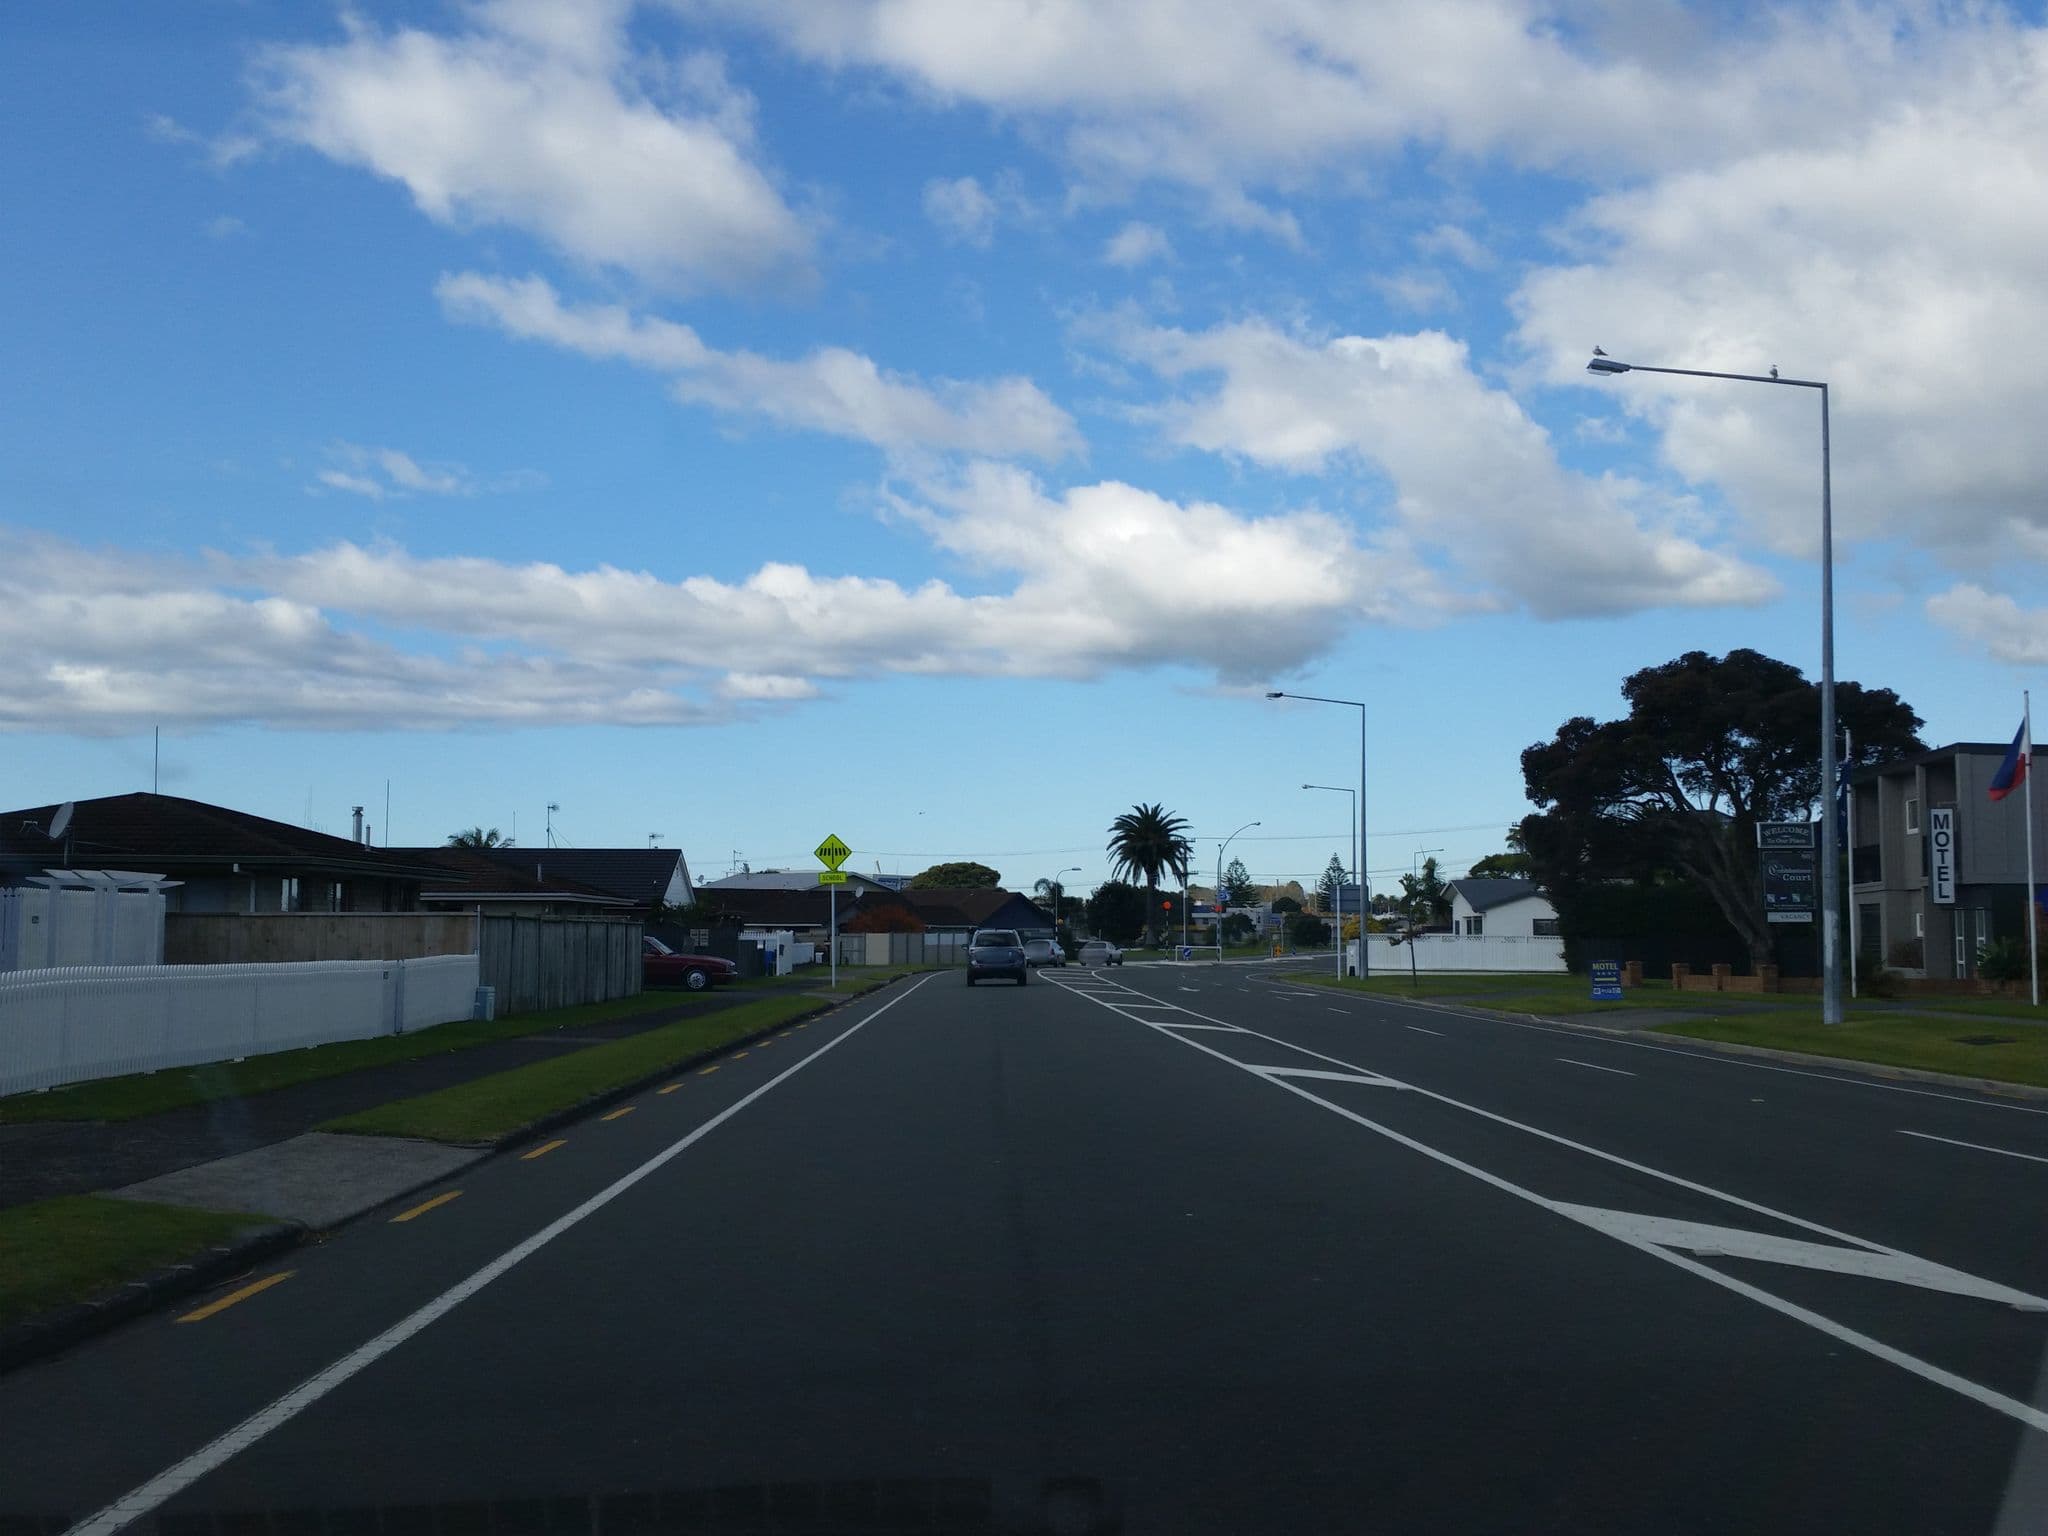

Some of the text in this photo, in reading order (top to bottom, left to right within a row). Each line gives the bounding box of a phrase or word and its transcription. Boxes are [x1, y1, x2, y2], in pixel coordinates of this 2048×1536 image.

[1762, 826, 1809, 837] WELCOME
[1933, 814, 1950, 898] MOTEL
[1782, 873, 1811, 881] Court
[1592, 962, 1618, 970] MOTEL
